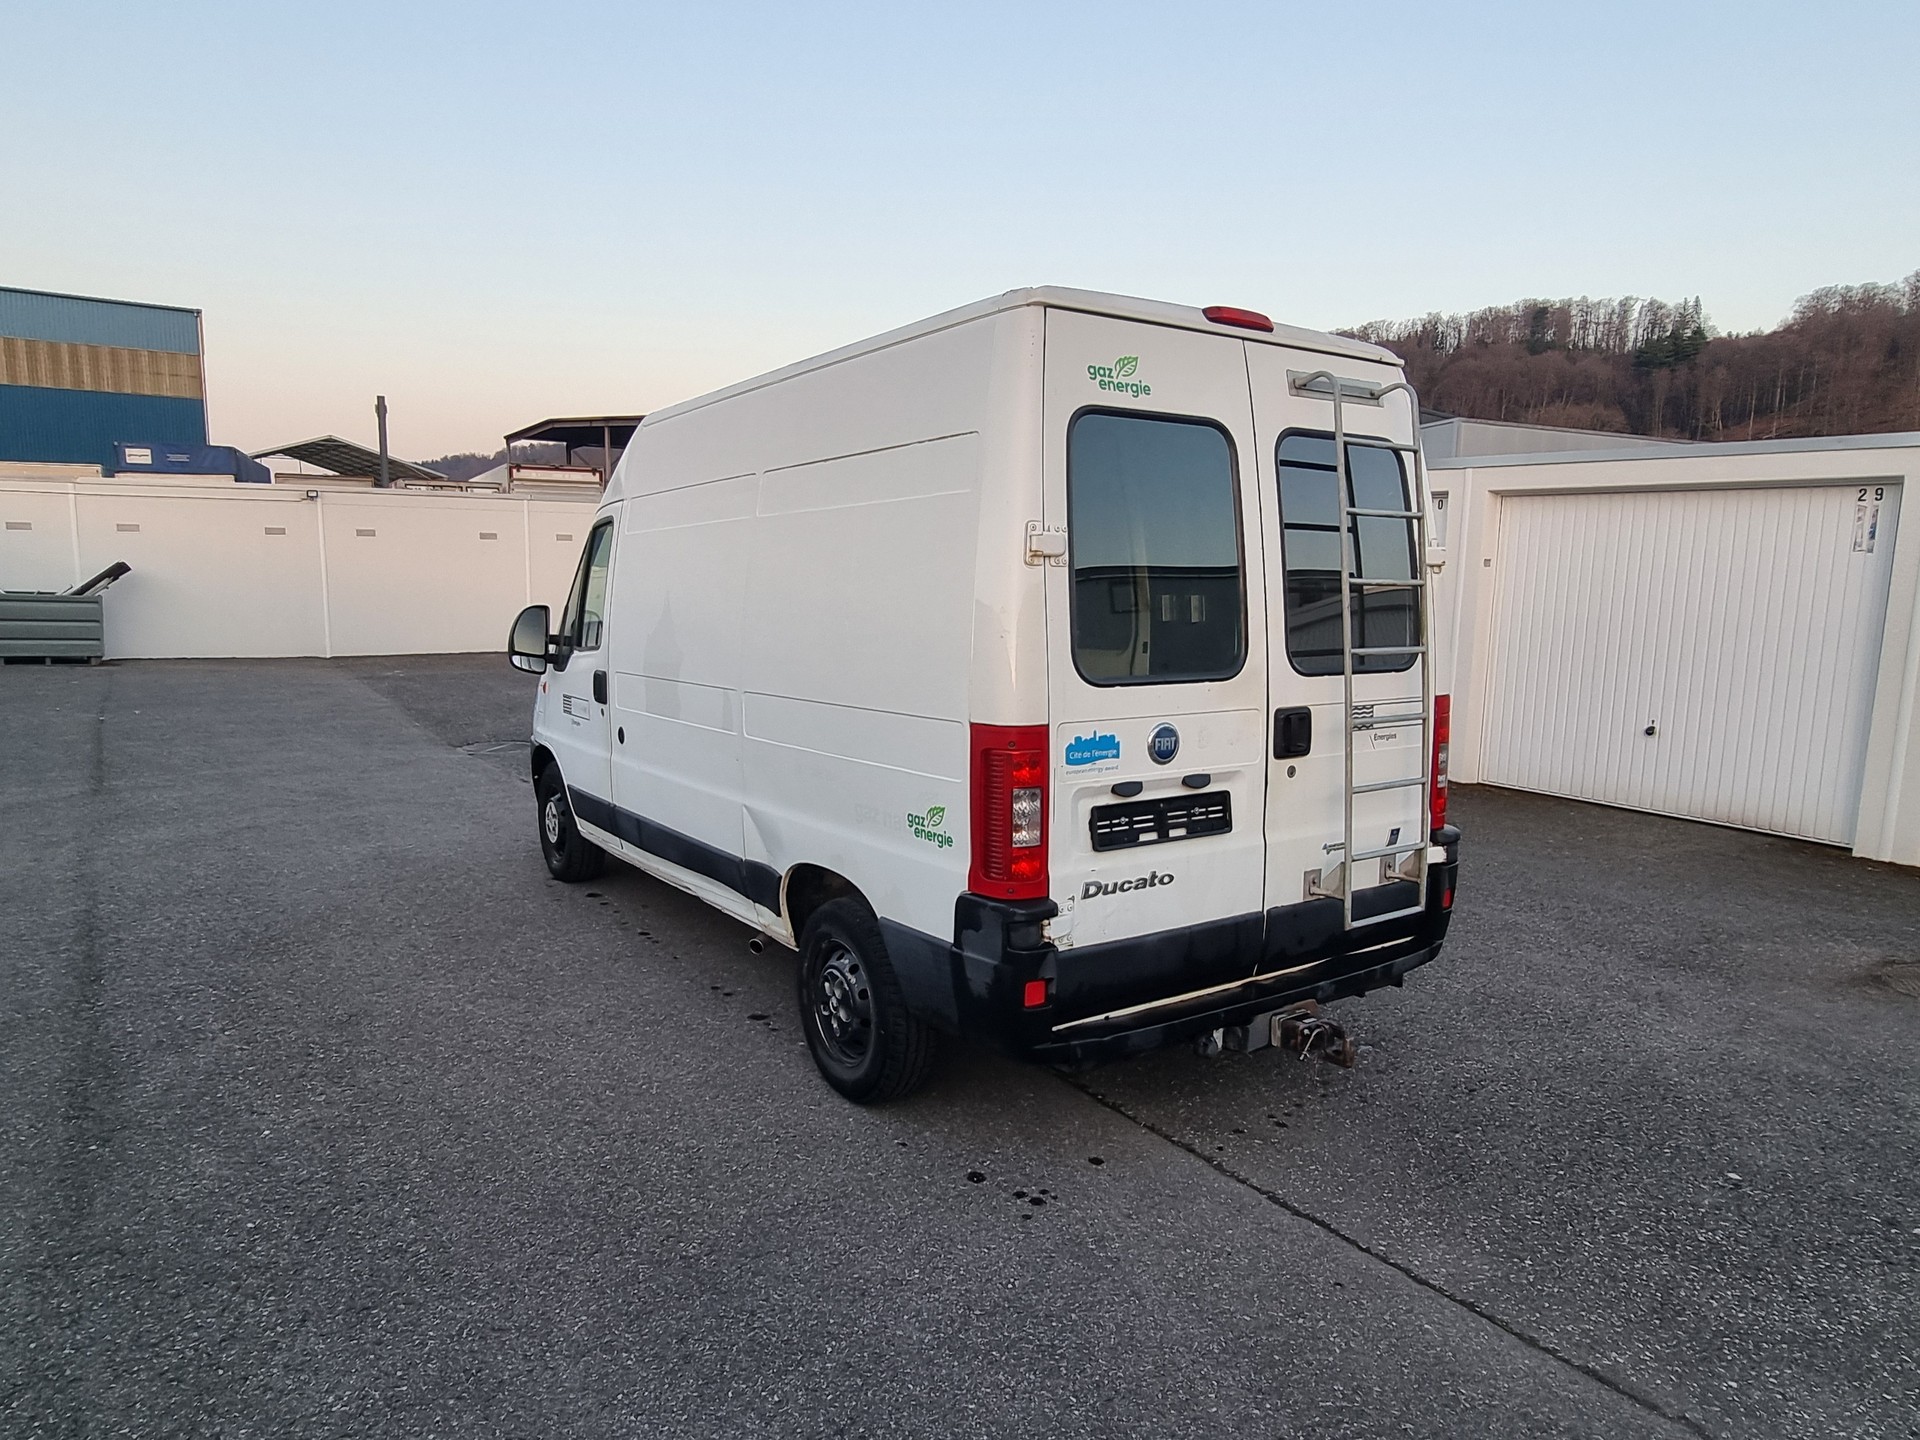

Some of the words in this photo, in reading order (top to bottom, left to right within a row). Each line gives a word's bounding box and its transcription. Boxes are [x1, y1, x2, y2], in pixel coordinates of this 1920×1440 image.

[1087, 364, 1114, 380] gaz
[1099, 379, 1152, 398] energie
[1155, 737, 1176, 750] FIAT
[907, 812, 926, 828] gaz
[914, 827, 954, 848] energie
[1081, 871, 1174, 900] Ducato
